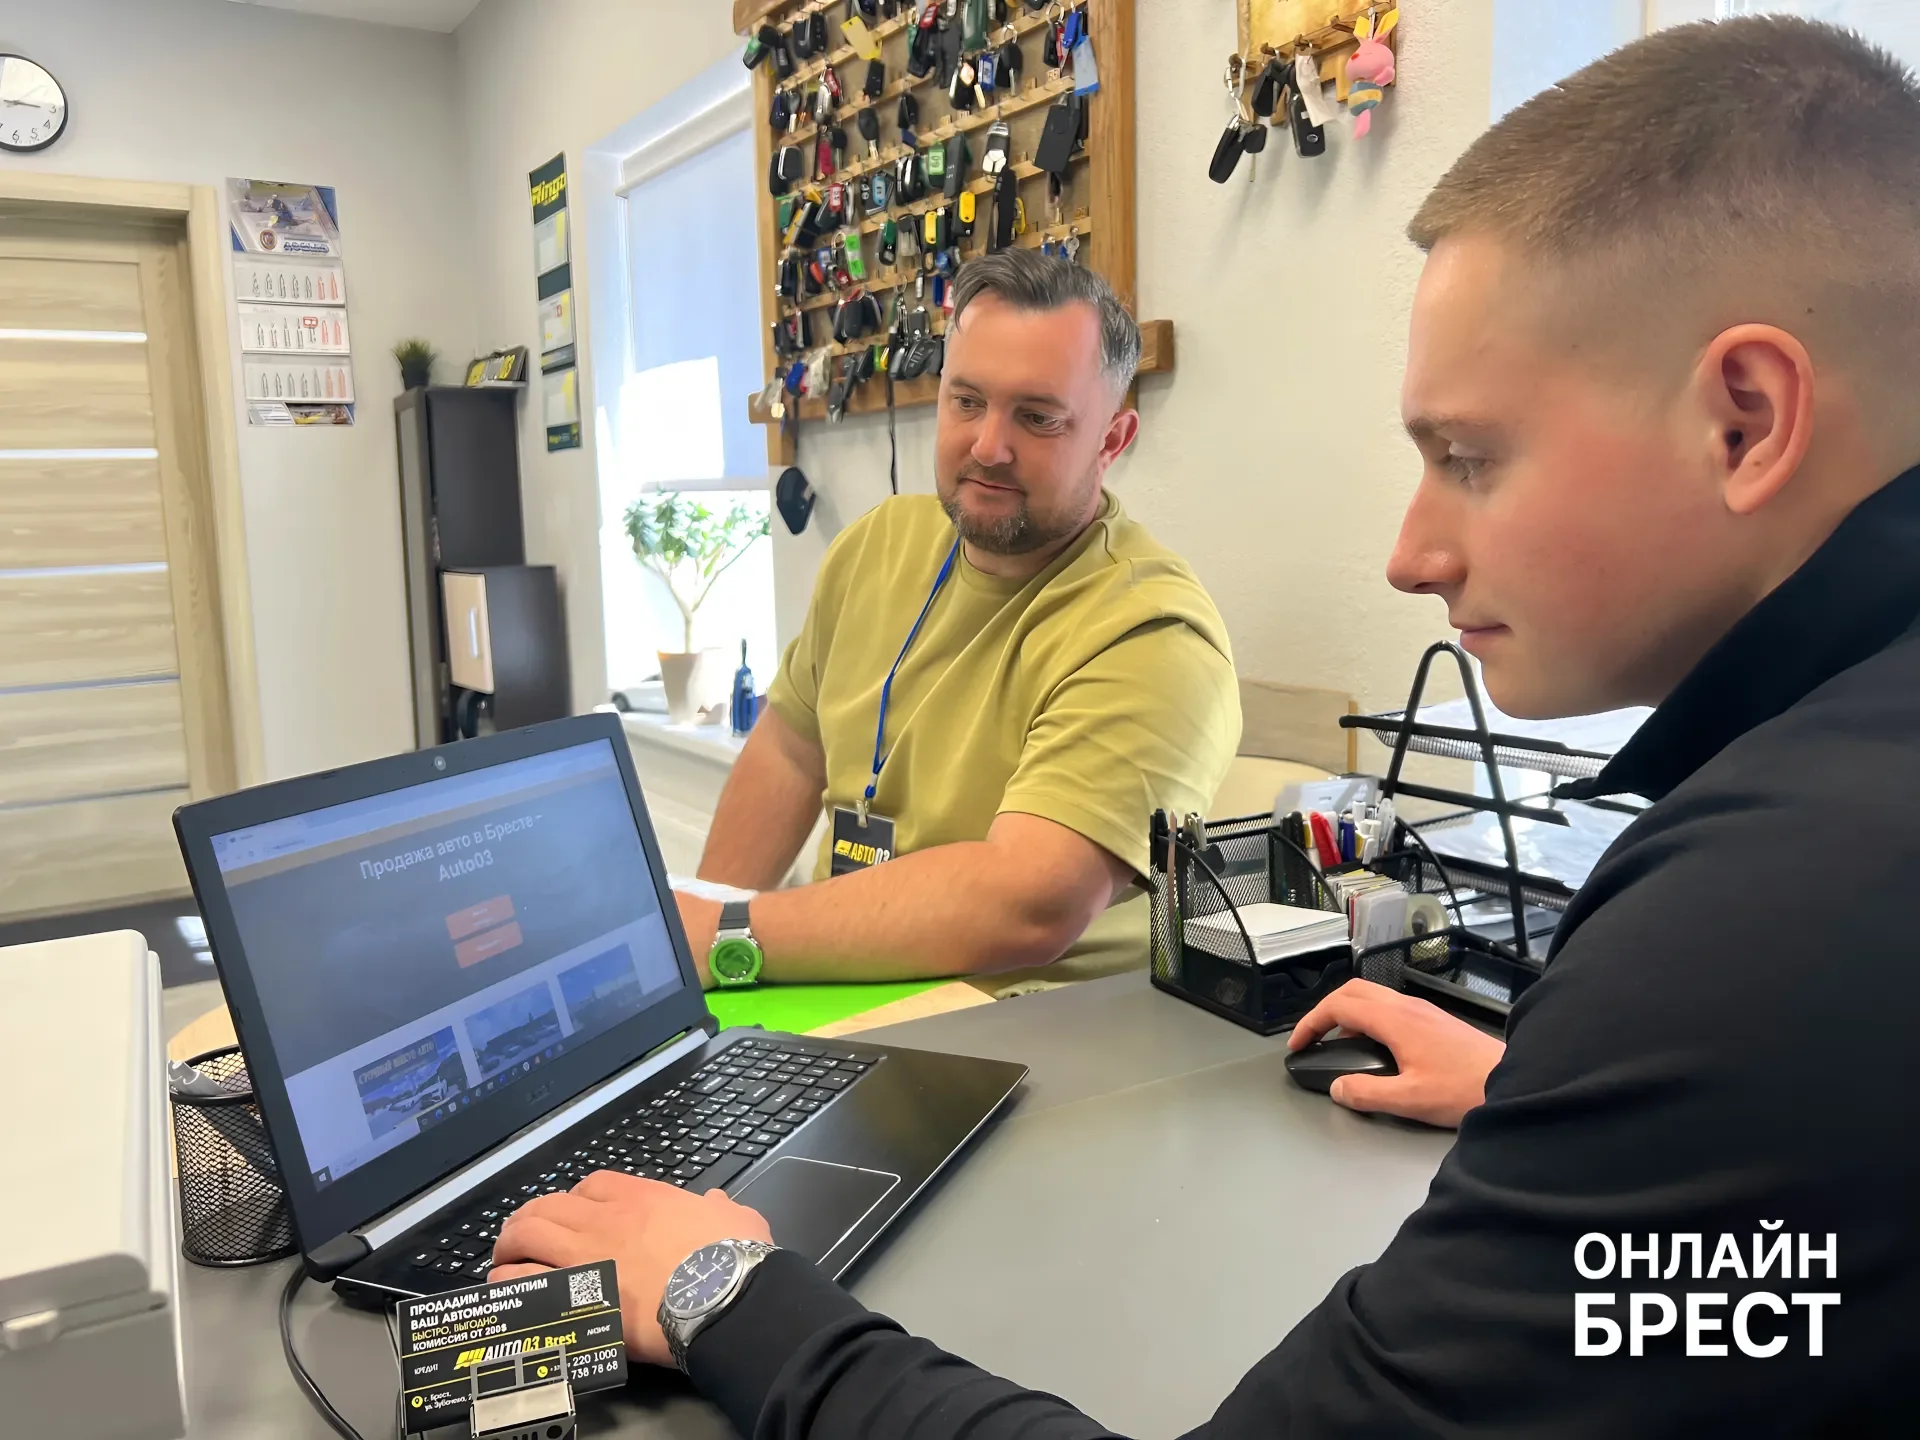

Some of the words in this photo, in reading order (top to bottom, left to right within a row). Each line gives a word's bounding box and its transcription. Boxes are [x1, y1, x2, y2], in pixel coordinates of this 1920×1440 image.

[359, 846, 435, 880] Продажа
[436, 835, 472, 856] авто
[474, 831, 484, 844] в
[484, 815, 534, 842] Бресте
[439, 849, 495, 882] Auto03
[410, 1292, 480, 1317] ПРОДАДИМ
[489, 1278, 548, 1300] ВЫКУПИМ
[410, 1315, 439, 1331] ВАШ
[442, 1298, 523, 1324] АВТОМОБИЛЬ
[453, 1315, 498, 1333] ВЫГОДНО
[413, 1332, 469, 1352] КОМИССИЯ
[470, 1330, 483, 1339] ОТ
[544, 1331, 577, 1349] Brest
[572, 1354, 592, 1367] 220
[594, 1348, 618, 1362] 1000
[571, 1366, 590, 1380] 738
[592, 1363, 604, 1375] 78
[606, 1360, 619, 1371] 68
